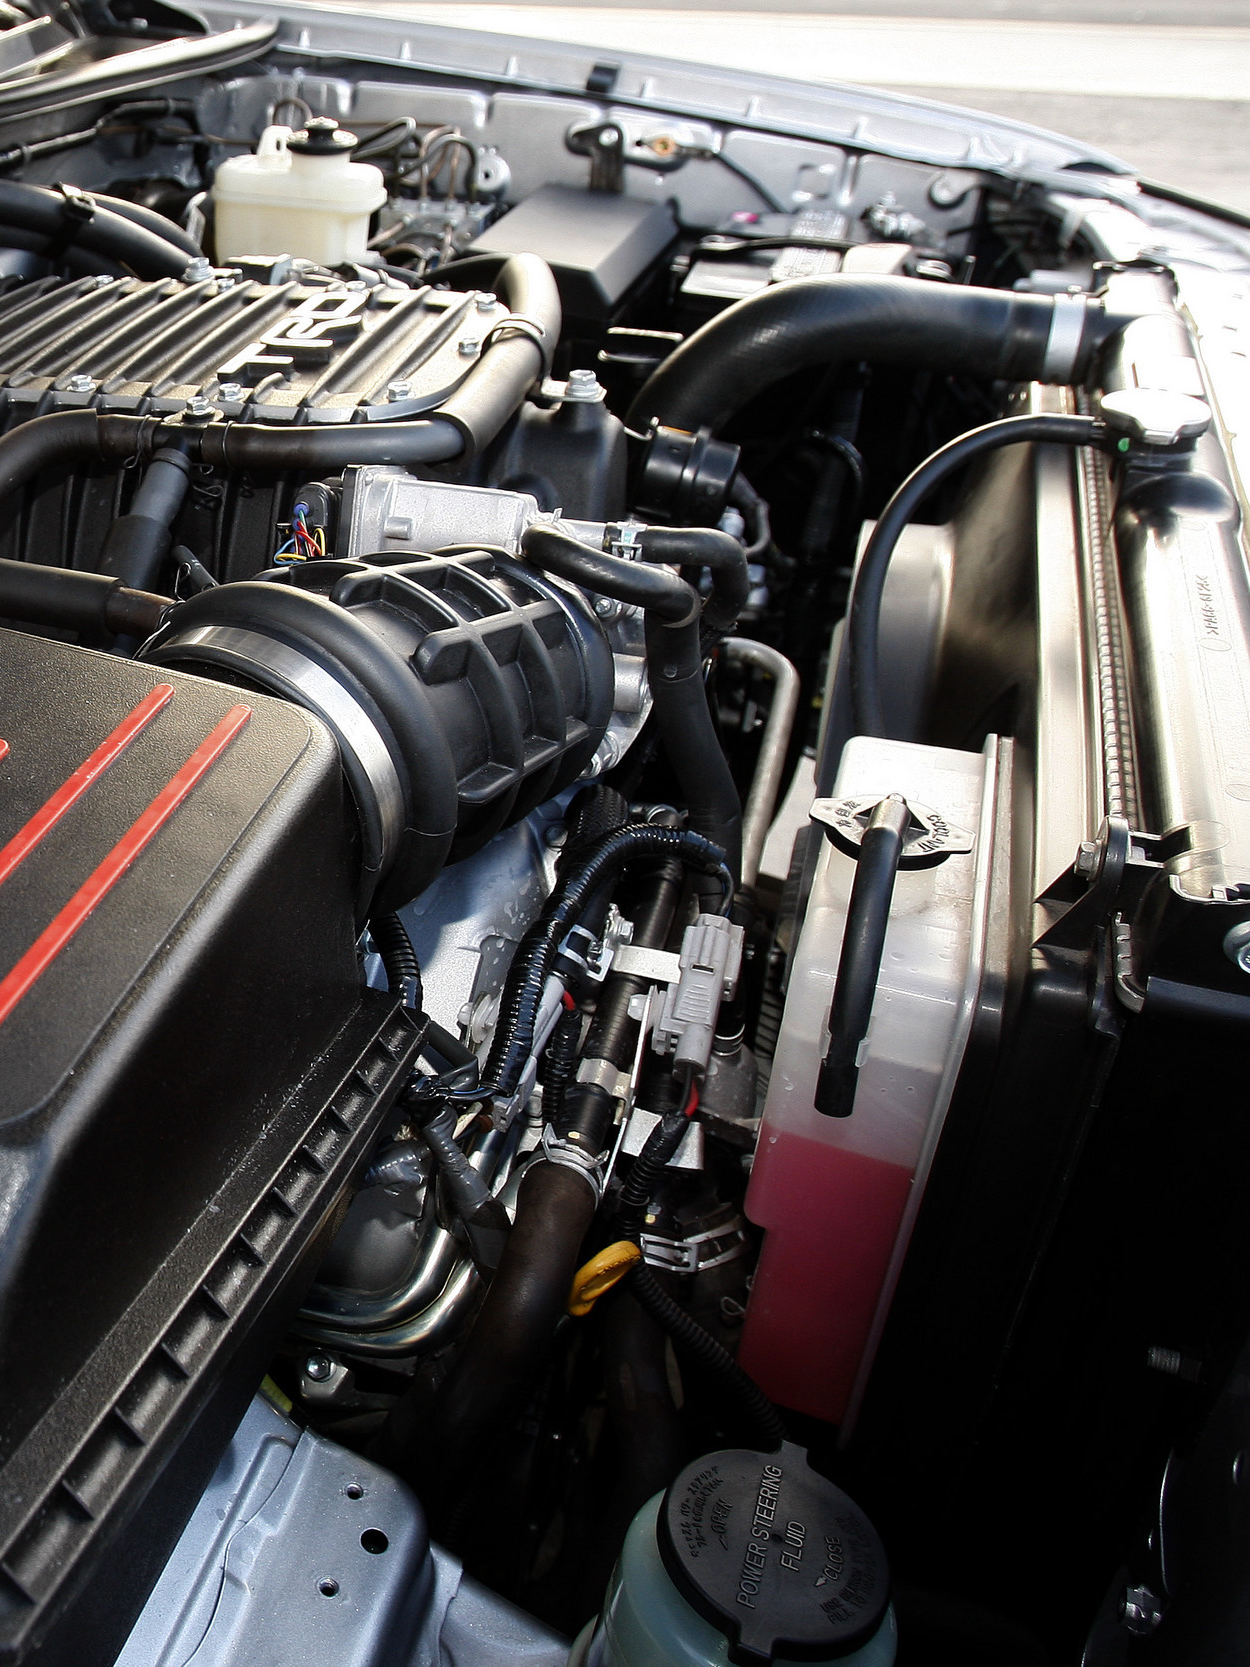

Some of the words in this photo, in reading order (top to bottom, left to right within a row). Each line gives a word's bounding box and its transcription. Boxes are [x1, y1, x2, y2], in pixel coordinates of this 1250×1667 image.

[217, 290, 368, 380] TRD
[916, 813, 950, 852] COOLANT
[710, 1498, 733, 1534] OPEN
[735, 1542, 767, 1609] POWER
[751, 1464, 782, 1541] STEERING
[779, 1519, 808, 1572] FLUID
[822, 1536, 844, 1581] CLOSE
